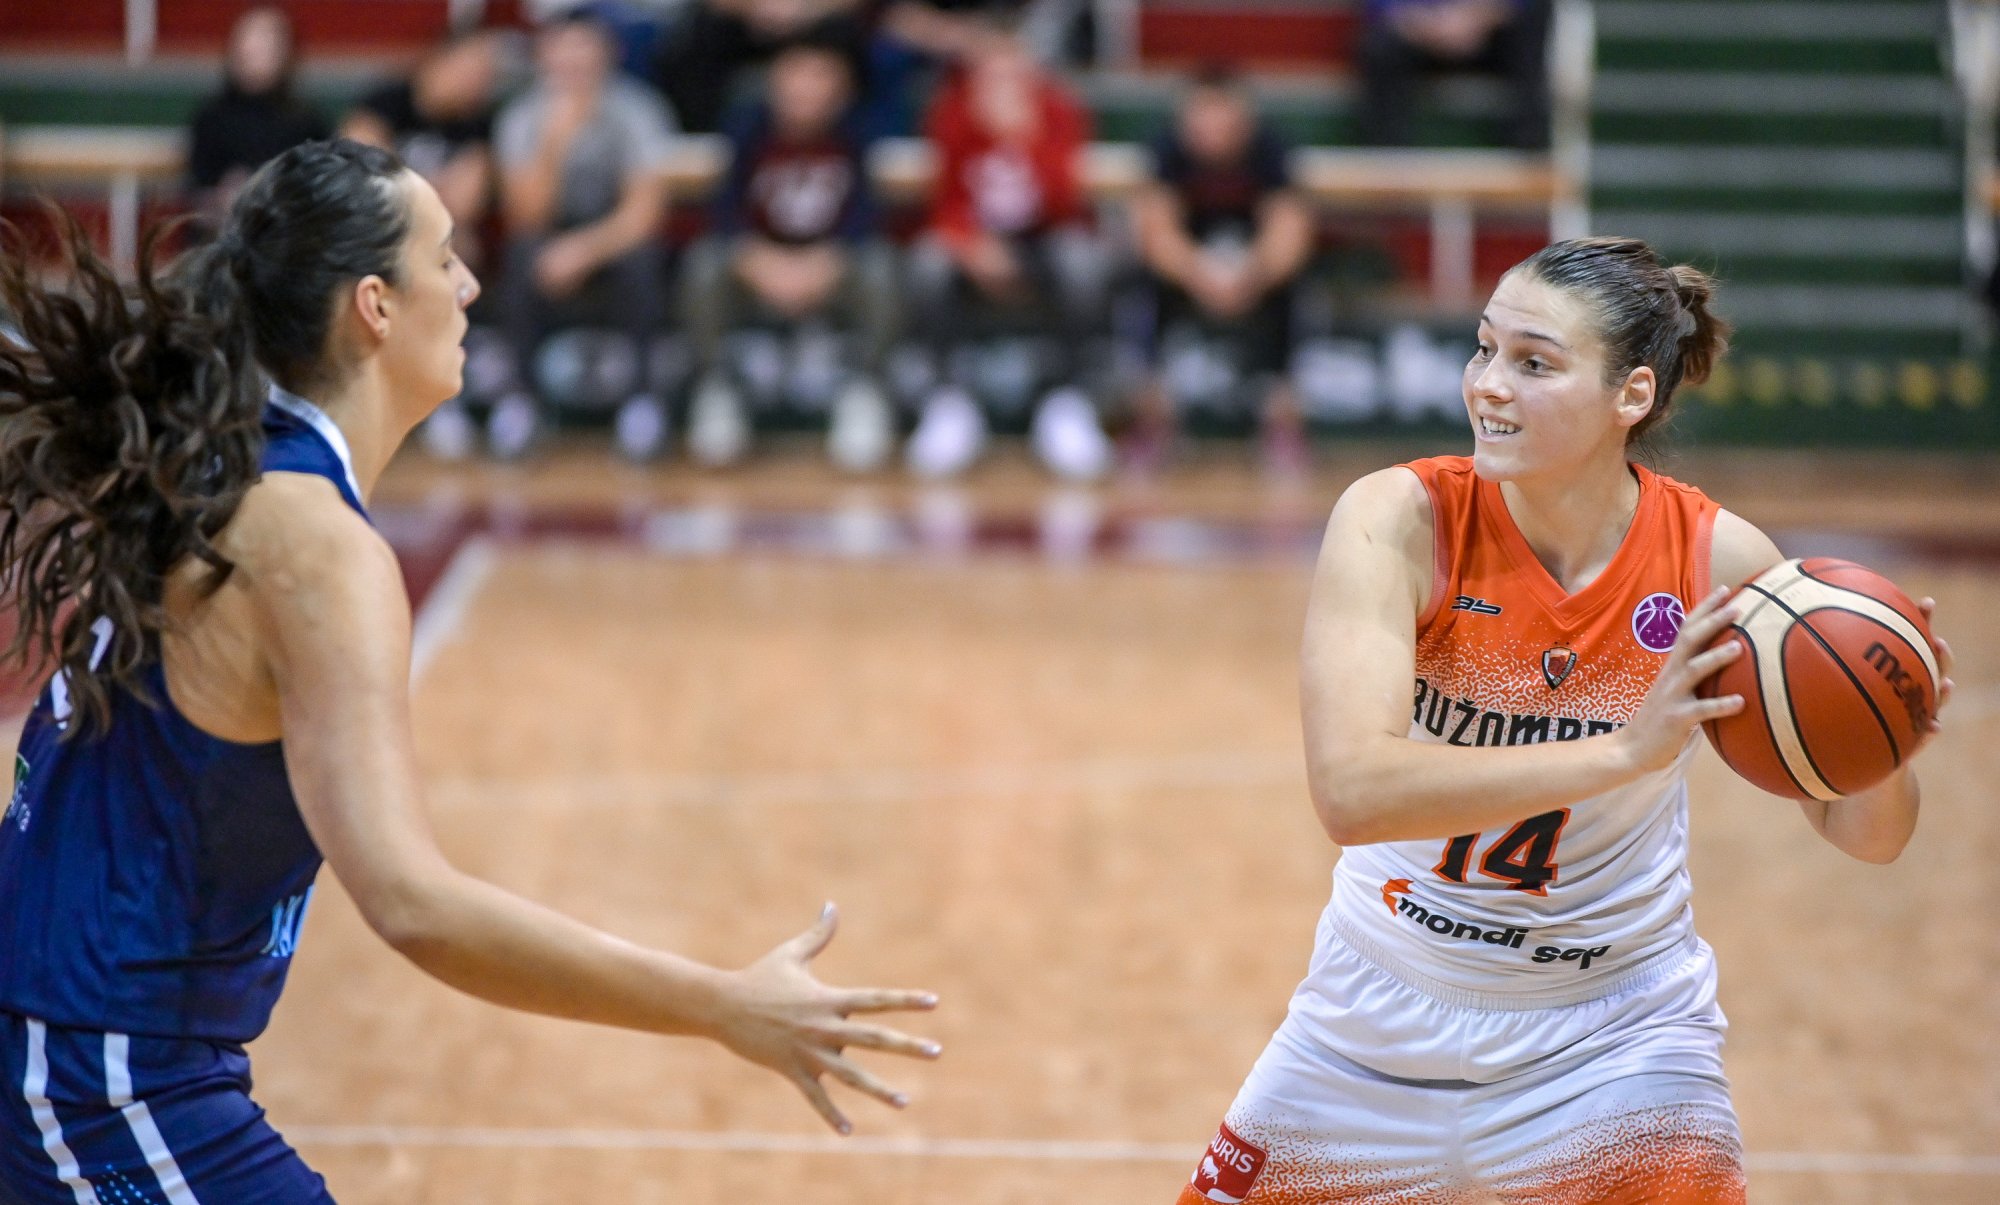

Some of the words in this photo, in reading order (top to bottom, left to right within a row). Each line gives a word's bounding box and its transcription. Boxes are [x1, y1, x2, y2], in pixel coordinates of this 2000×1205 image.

[1431, 807, 1572, 897] 14
[1397, 896, 1530, 949] mondi
[1211, 1130, 1255, 1173] URIS
